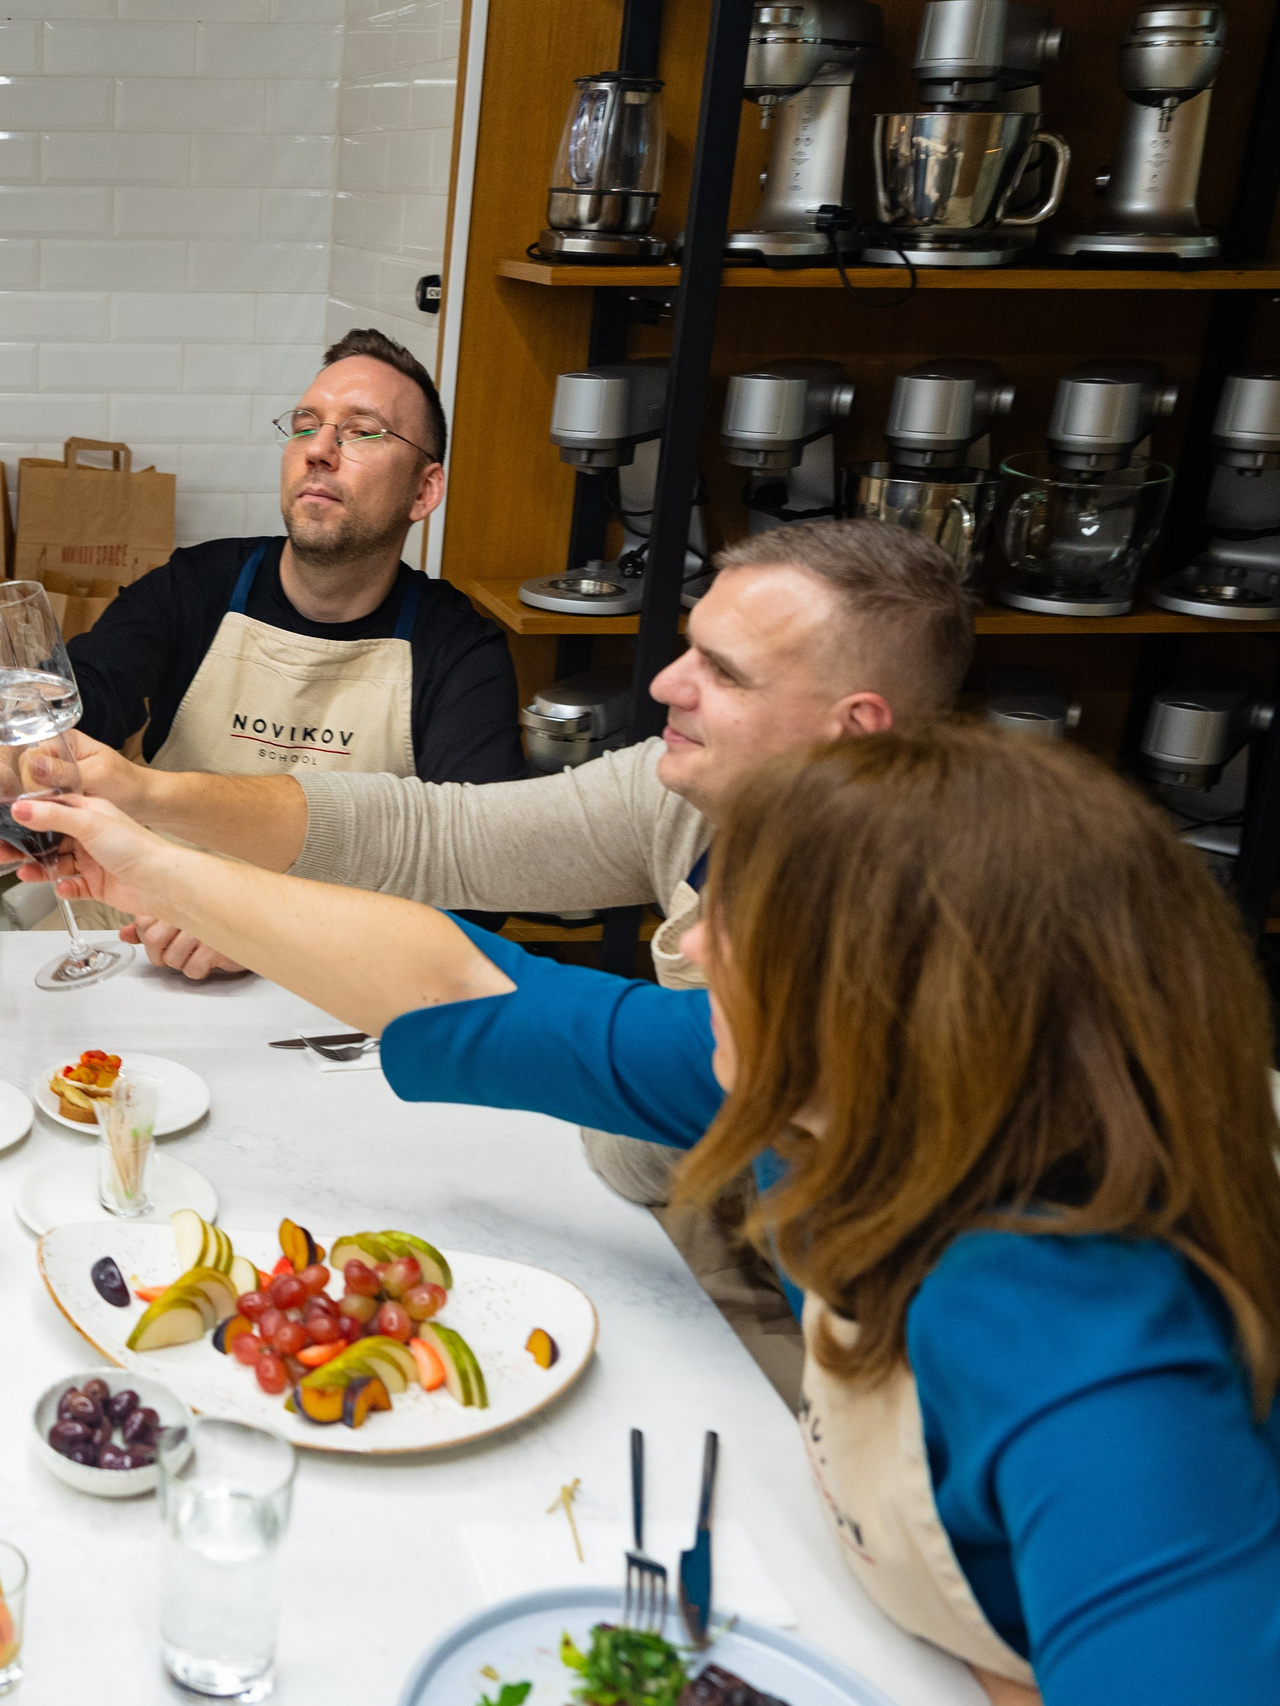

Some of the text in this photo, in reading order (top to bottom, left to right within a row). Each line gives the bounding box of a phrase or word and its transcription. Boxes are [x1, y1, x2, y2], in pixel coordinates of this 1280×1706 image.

[95, 544, 128, 567] SPACE
[233, 713, 354, 746] NOVIKOV
[258, 748, 317, 766] SCHOOL
